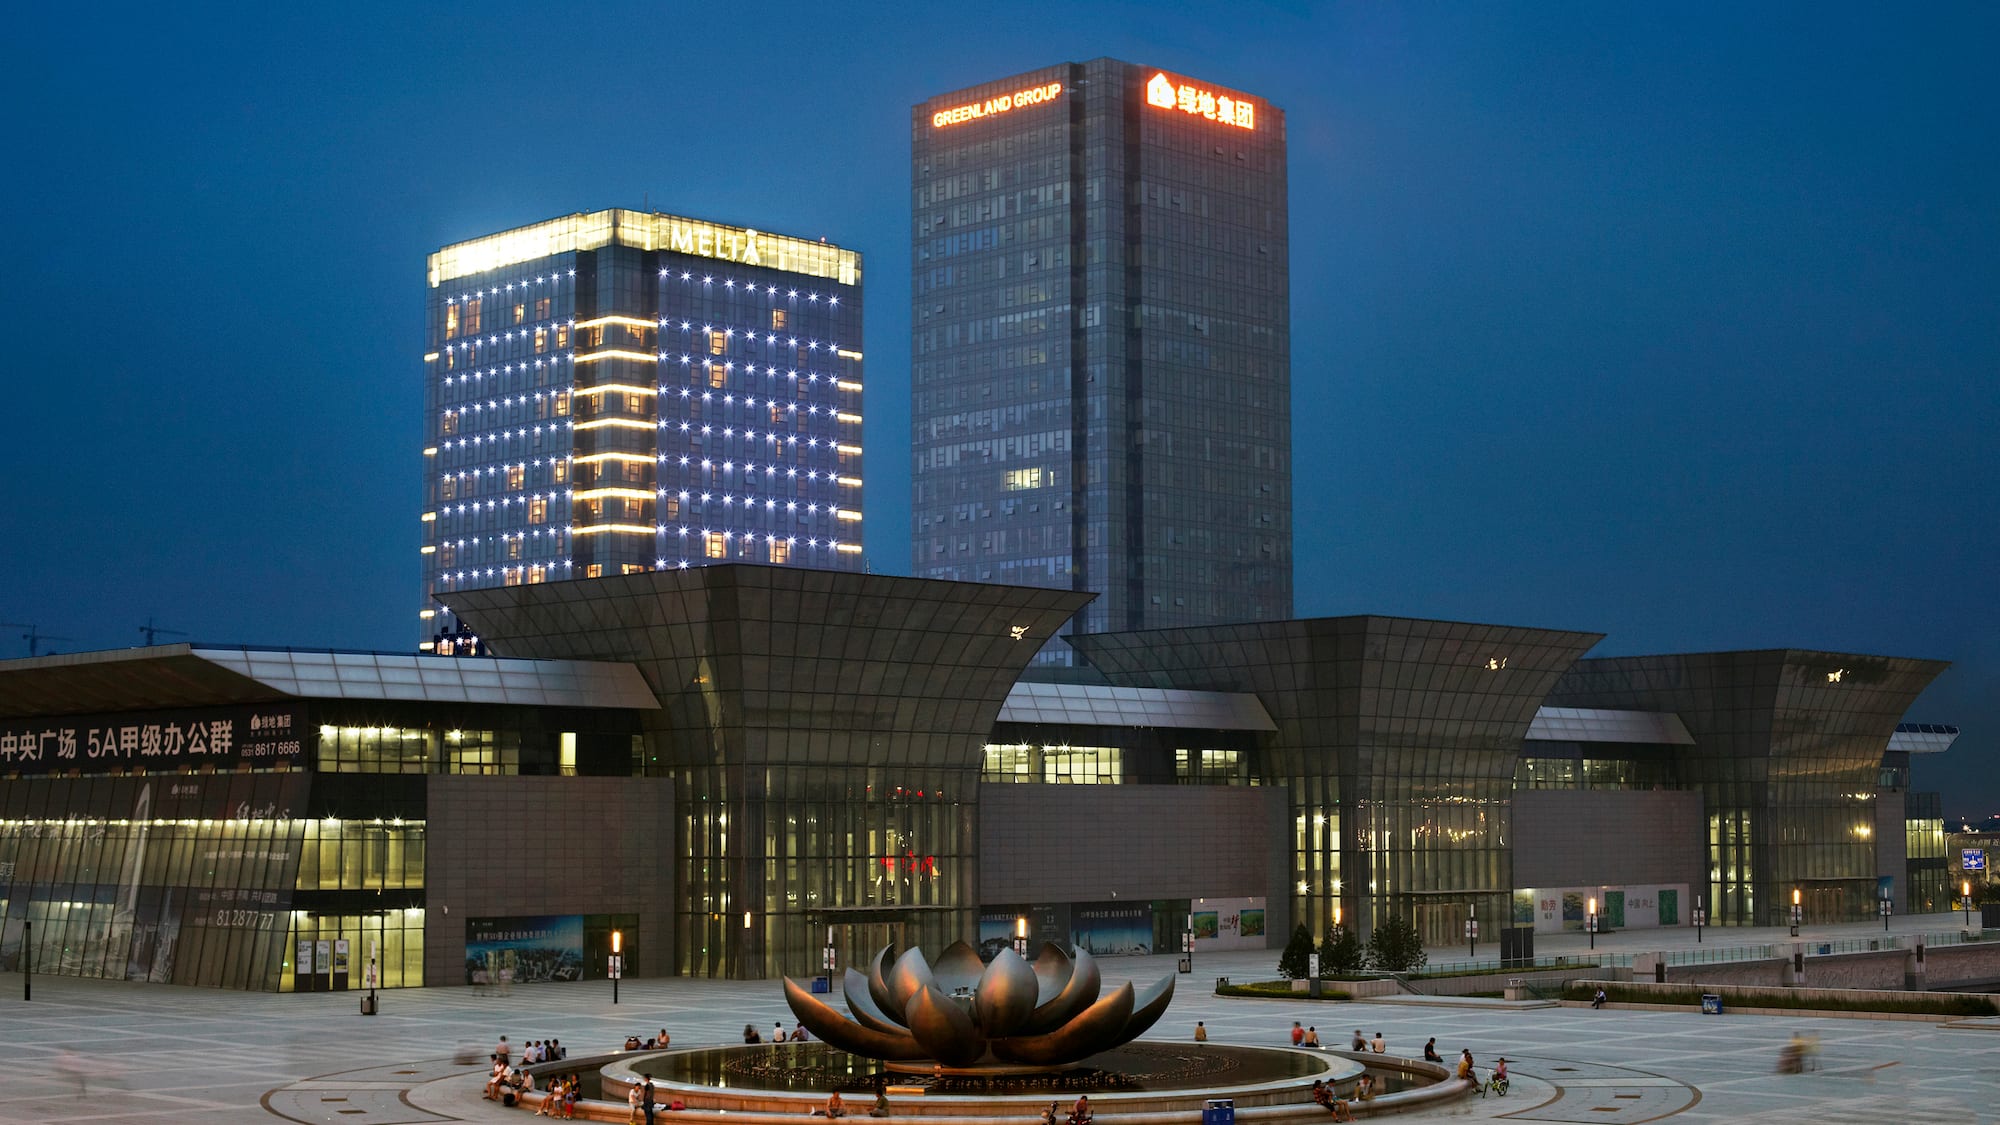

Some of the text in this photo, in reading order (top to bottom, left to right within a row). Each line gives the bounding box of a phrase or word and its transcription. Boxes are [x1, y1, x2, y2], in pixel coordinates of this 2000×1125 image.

[933, 83, 1062, 127] GREENLAND GROUP
[1177, 85, 1254, 130] 绿地集团
[0, 719, 233, 762] 中央广场 5A甲级办公群
[255, 742, 276, 756] 8617
[278, 741, 300, 755] 6666
